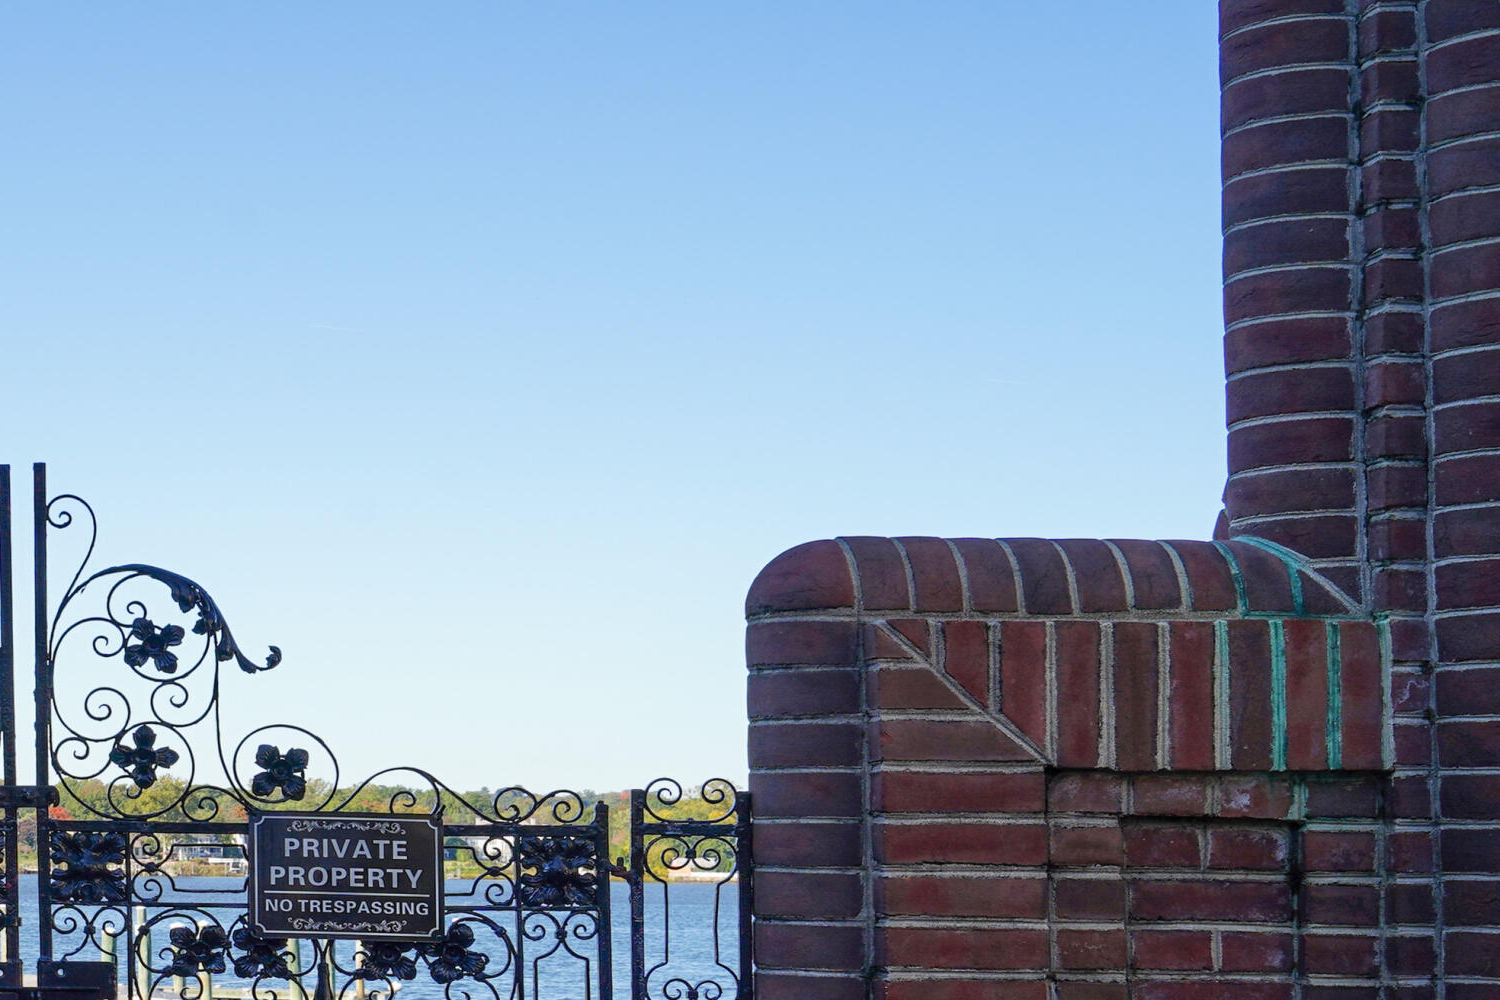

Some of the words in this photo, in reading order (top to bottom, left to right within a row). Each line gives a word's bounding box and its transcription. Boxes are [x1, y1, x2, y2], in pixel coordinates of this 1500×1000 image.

[284, 837, 408, 861] PRIVATE
[270, 866, 423, 889] PROPERTY
[265, 899, 293, 913] NO
[297, 899, 429, 916] TRESPASSING
